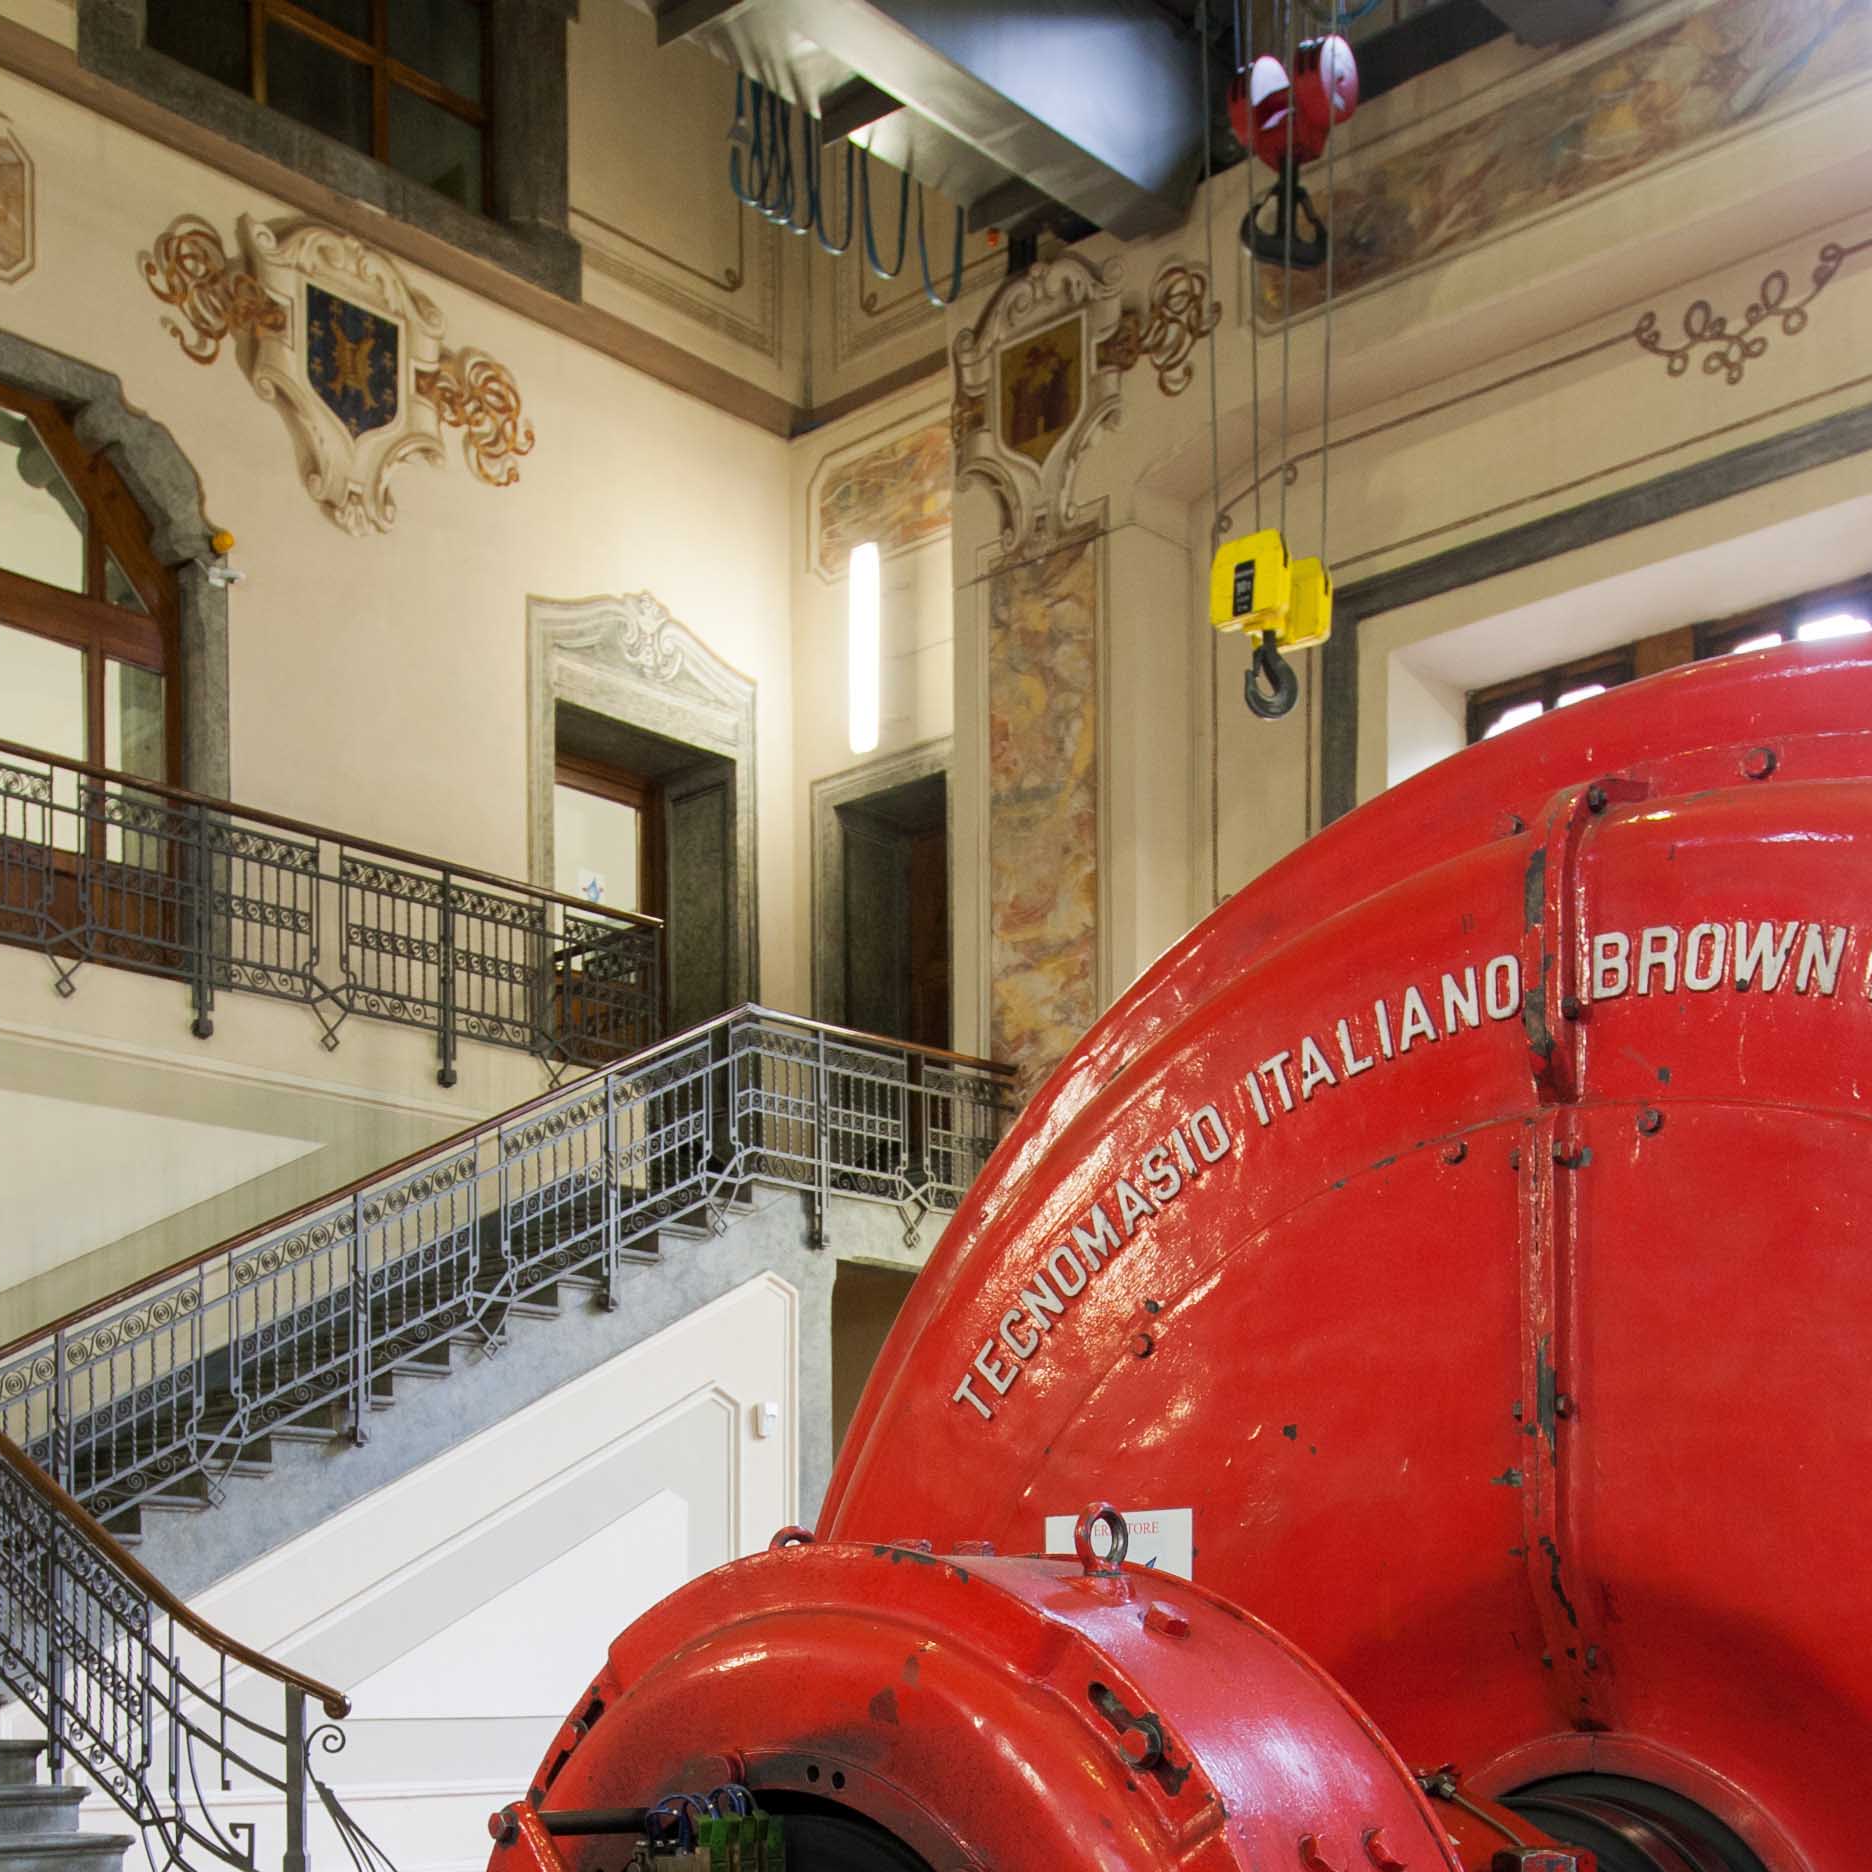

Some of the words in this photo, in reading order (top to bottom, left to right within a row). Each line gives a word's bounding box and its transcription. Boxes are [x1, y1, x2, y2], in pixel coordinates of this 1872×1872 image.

[951, 1102, 1231, 1421] TECNOMASIO
[1246, 953, 1520, 1127] ITALIANO
[1592, 920, 1849, 999] BROWN
